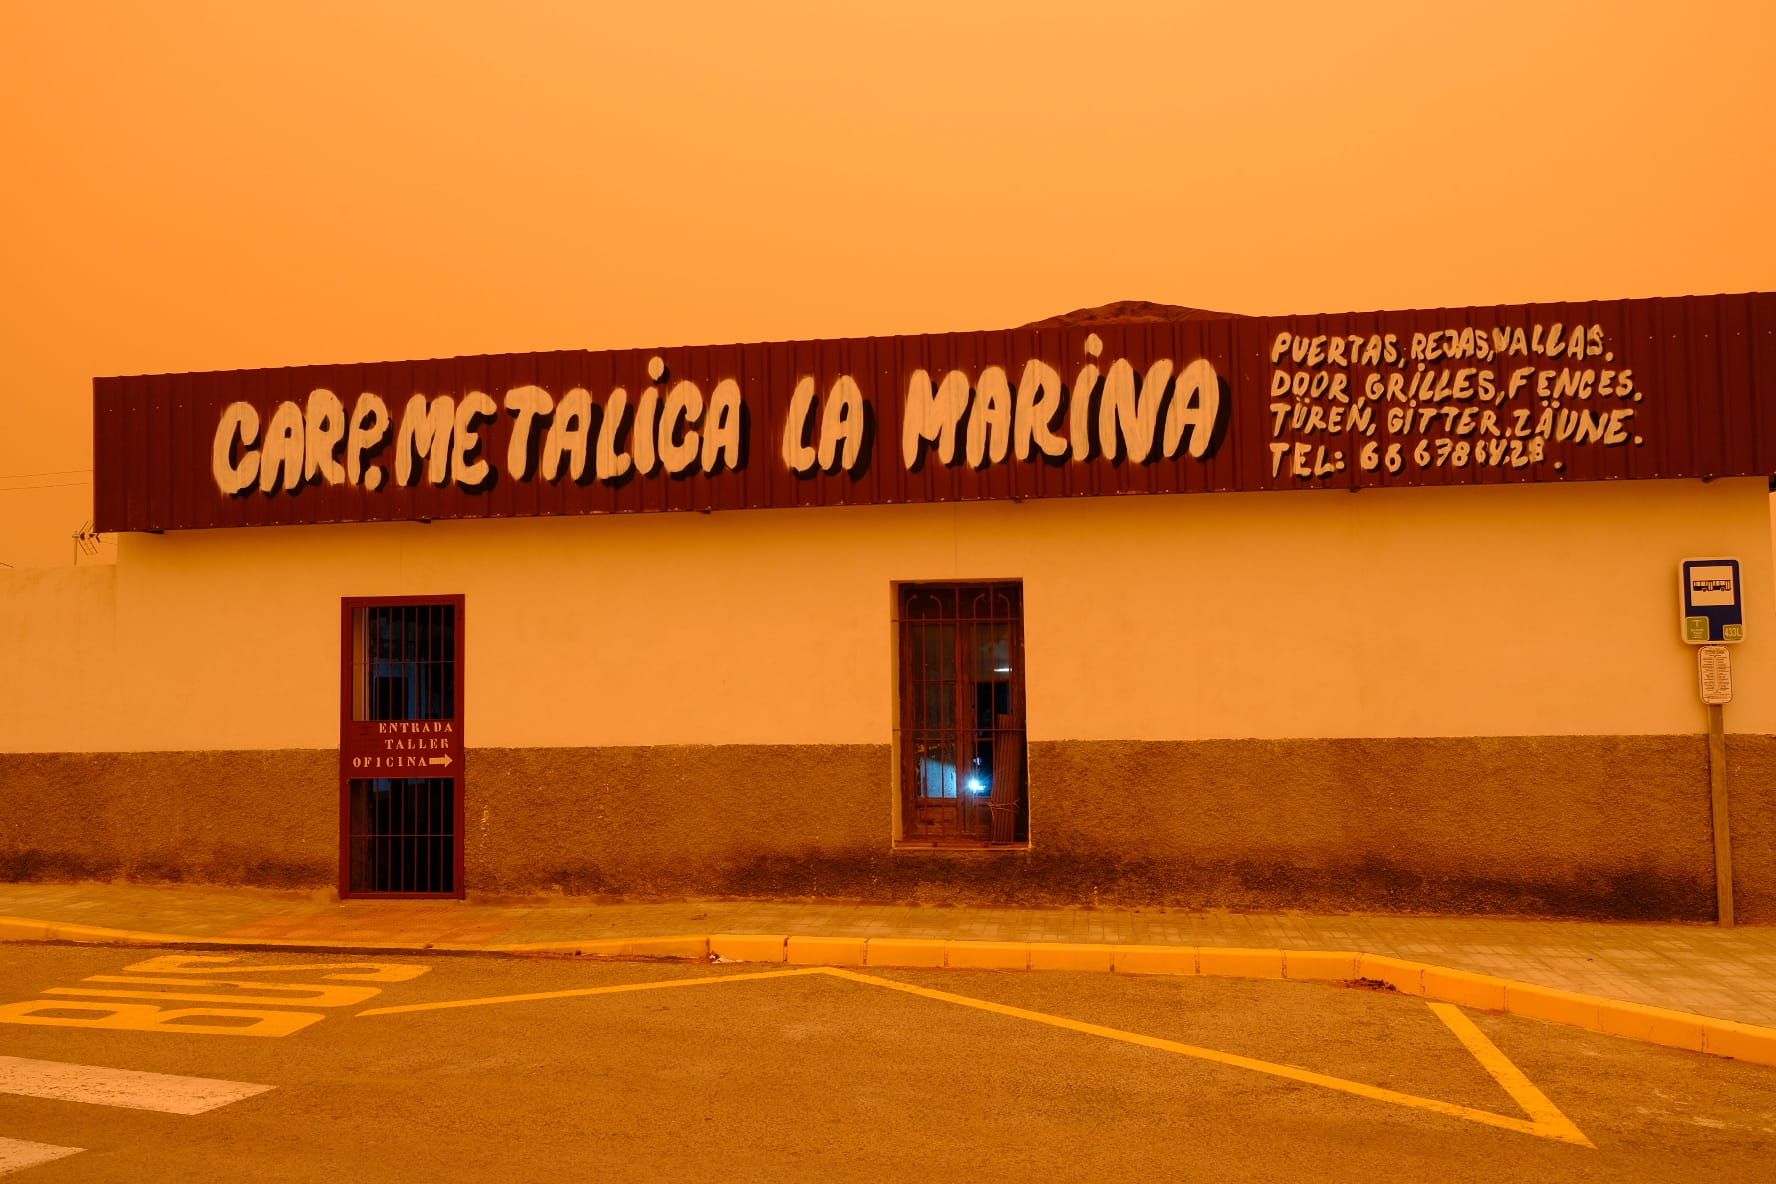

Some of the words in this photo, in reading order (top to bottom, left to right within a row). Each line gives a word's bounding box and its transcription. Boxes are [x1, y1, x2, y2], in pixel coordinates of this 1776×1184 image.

[1271, 332, 1405, 368] PUERTAS,
[782, 374, 864, 473] LA
[1270, 442, 1345, 478] TEL:
[379, 721, 453, 734] ENTRADA
[384, 738, 449, 750] TALLER
[352, 756, 428, 768] OFICINA
[0, 955, 433, 1037] BUS
